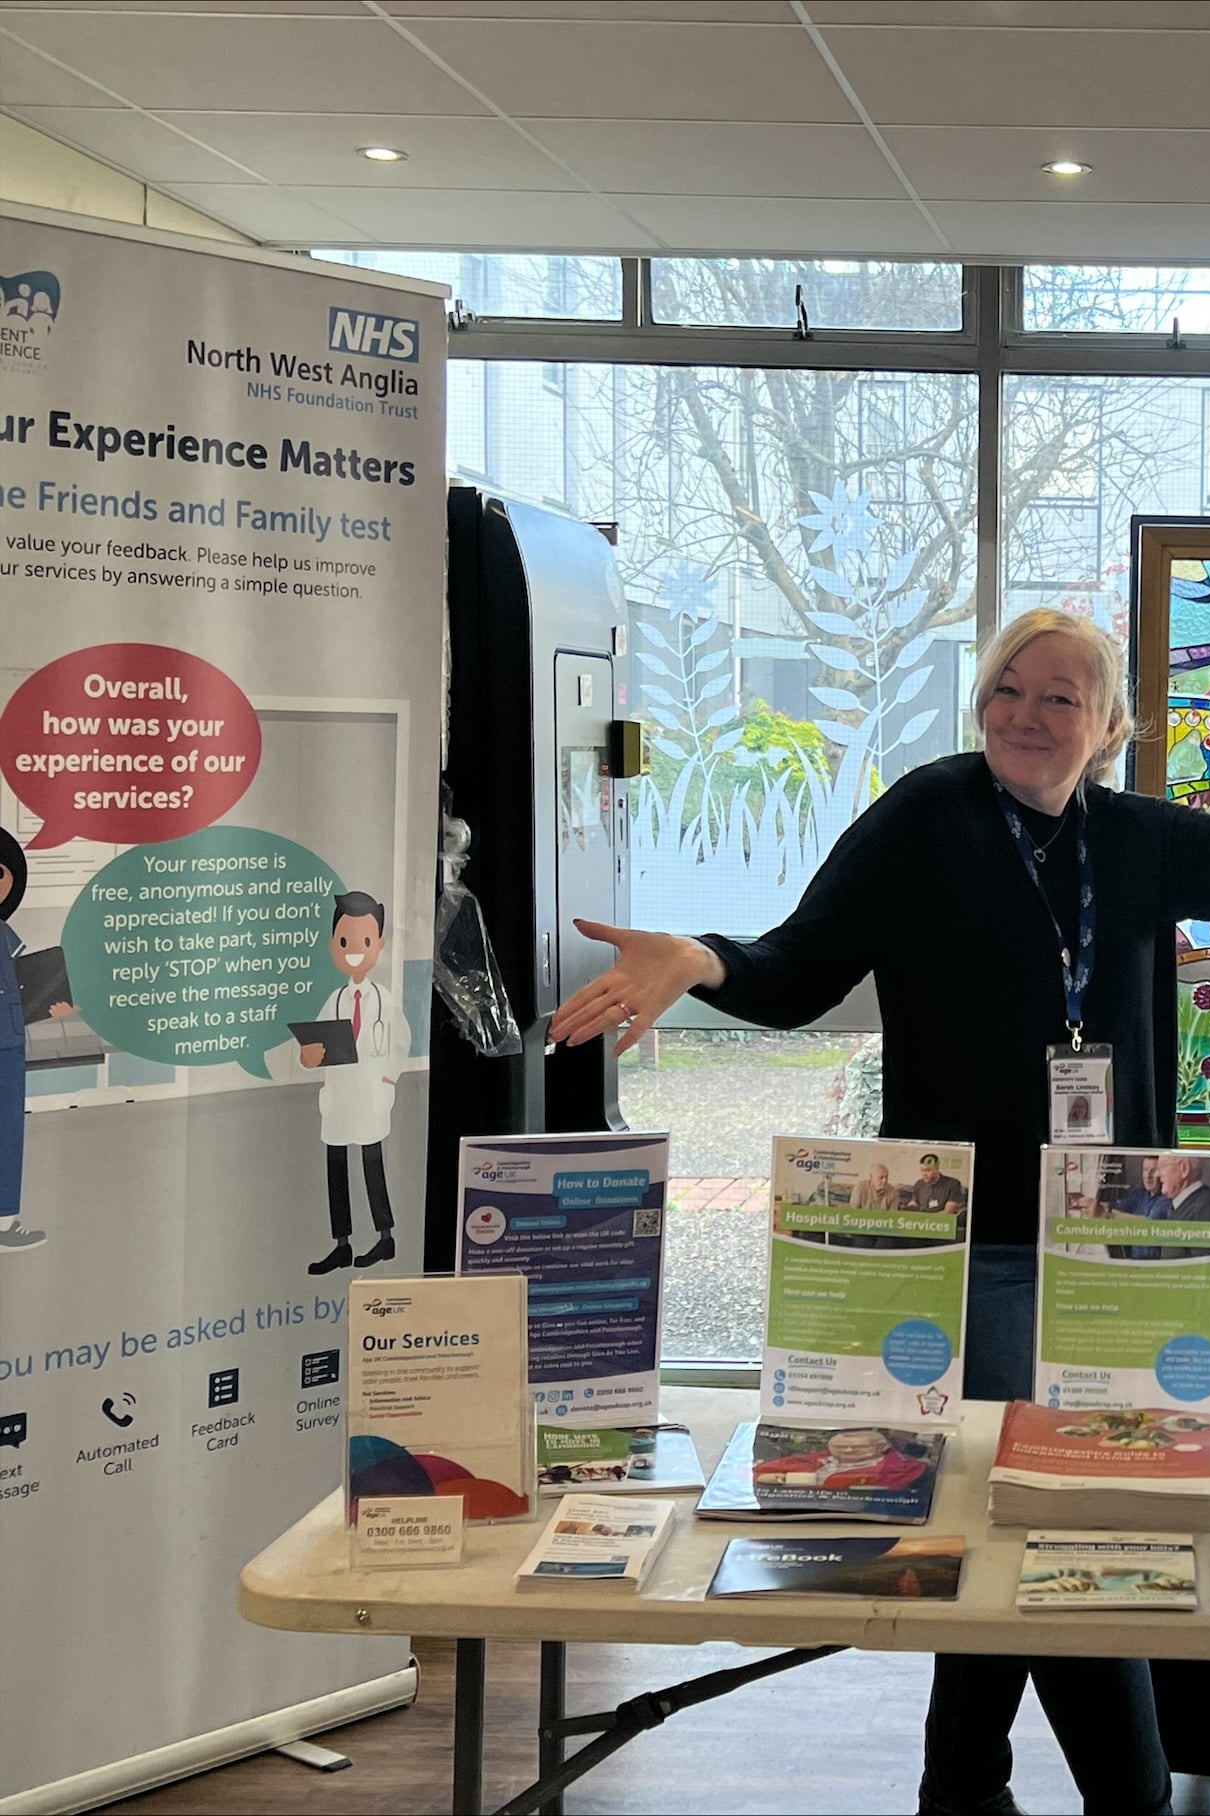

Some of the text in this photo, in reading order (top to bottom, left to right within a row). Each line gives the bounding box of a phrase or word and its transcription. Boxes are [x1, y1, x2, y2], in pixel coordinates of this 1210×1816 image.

[331, 311, 416, 358] NHS
[187, 339, 418, 399] North West Anglia
[247, 382, 418, 420] NHS Foundation Trust
[49, 410, 268, 470] Experience
[280, 438, 416, 487] Matters
[38, 481, 392, 543] Friends and Family test
[6, 534, 377, 577] value your feedback. Please help us improve
[24, 562, 97, 581] services
[102, 566, 123, 587] by
[127, 570, 217, 593] answering
[220, 578, 230, 590] a
[234, 575, 288, 596] simple
[293, 583, 363, 600] question.
[84, 673, 188, 704] Overall,
[43, 710, 225, 743] how was your
[15, 748, 246, 778] experience of our
[73, 785, 194, 810] services?
[144, 852, 287, 875] Your response is
[91, 877, 333, 903] free, anonymous and really
[104, 902, 320, 931] appreciated! If you don't
[104, 928, 319, 954] wish to take part, simply
[112, 955, 311, 983] reply 'STOP' when you
[109, 979, 313, 1008] receive the message or
[147, 1005, 278, 1034] speak to a staff
[175, 1035, 250, 1056] member.
[796, 1158, 821, 1173] age
[557, 1176, 646, 1190] How to Donate
[562, 1196, 592, 1206] Online
[785, 1211, 950, 1232] Hospital Support Services
[1056, 1223, 1149, 1238] Cambridgeshire
[372, 1306, 393, 1318] age
[44, 1341, 111, 1372] may
[121, 1331, 158, 1358] be
[166, 1309, 246, 1349] asked
[255, 1300, 305, 1330] this
[313, 1296, 346, 1324] by
[362, 1330, 480, 1351] Our Services
[788, 1355, 838, 1367] Contact Us
[1062, 1369, 1112, 1380] Contact Us
[296, 1395, 341, 1414] Online
[191, 1411, 257, 1438] Feedback
[295, 1413, 341, 1432] Survey
[76, 1434, 160, 1464] Automated
[206, 1433, 240, 1452] Card
[103, 1458, 132, 1476] Call
[367, 1526, 396, 1537] 0300
[423, 1525, 452, 1536] 9860
